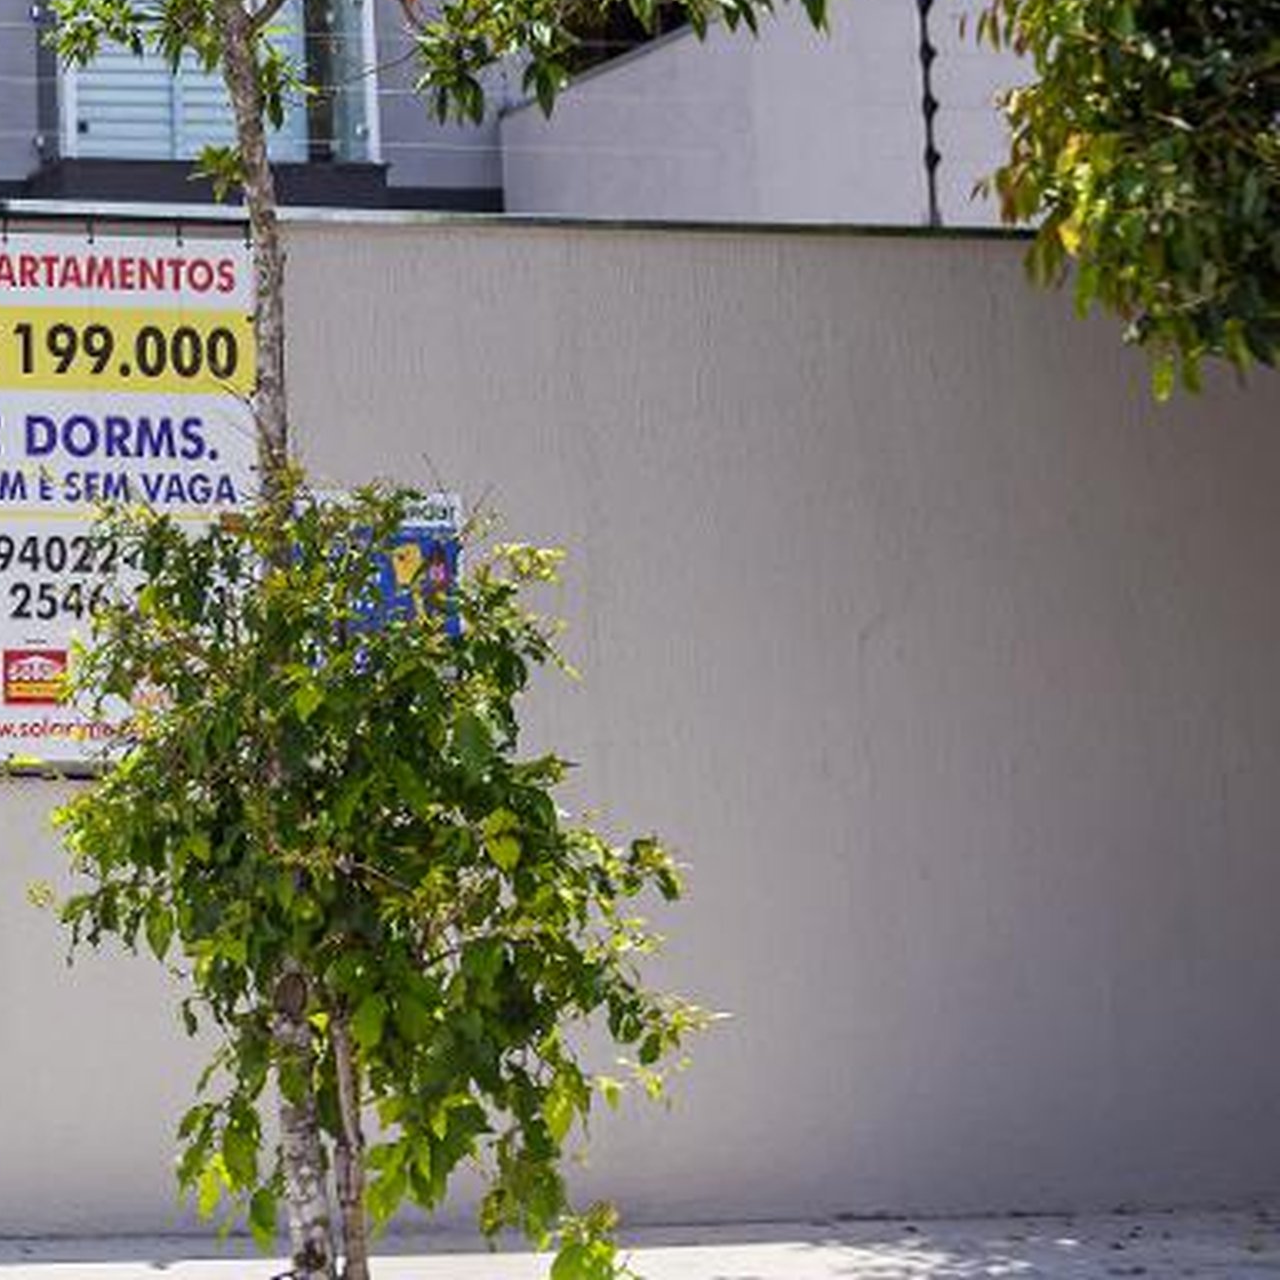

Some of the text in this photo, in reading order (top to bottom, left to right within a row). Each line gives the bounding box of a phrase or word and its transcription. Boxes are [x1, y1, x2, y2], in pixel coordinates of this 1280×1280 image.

[13, 322, 239, 378] 199.000
[25, 415, 218, 461] DORMS.
[64, 472, 130, 504] SEM
[142, 473, 237, 505] VAGA
